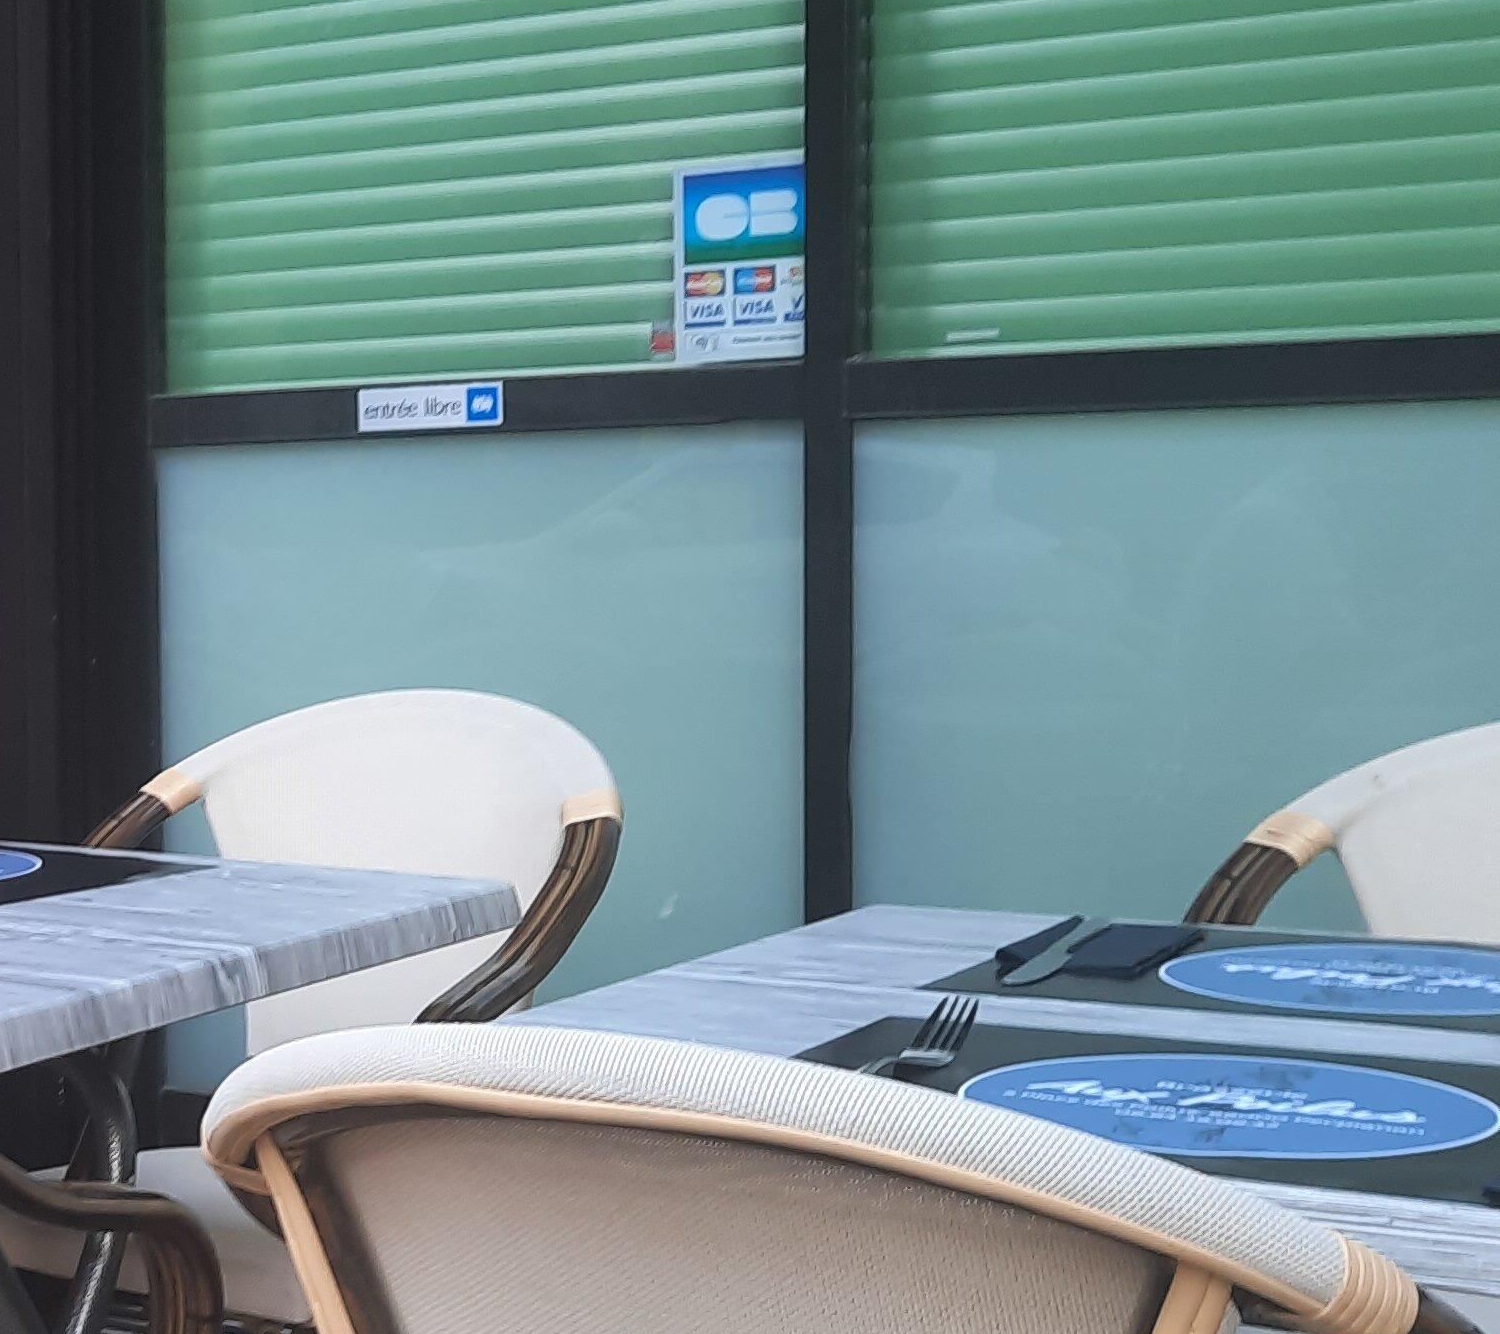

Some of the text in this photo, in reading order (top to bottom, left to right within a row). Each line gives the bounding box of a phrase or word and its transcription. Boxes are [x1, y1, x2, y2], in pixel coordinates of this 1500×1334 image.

[694, 188, 799, 242] CB
[691, 303, 724, 319] VISA
[741, 299, 773, 316] VISA
[422, 395, 462, 417] libre
